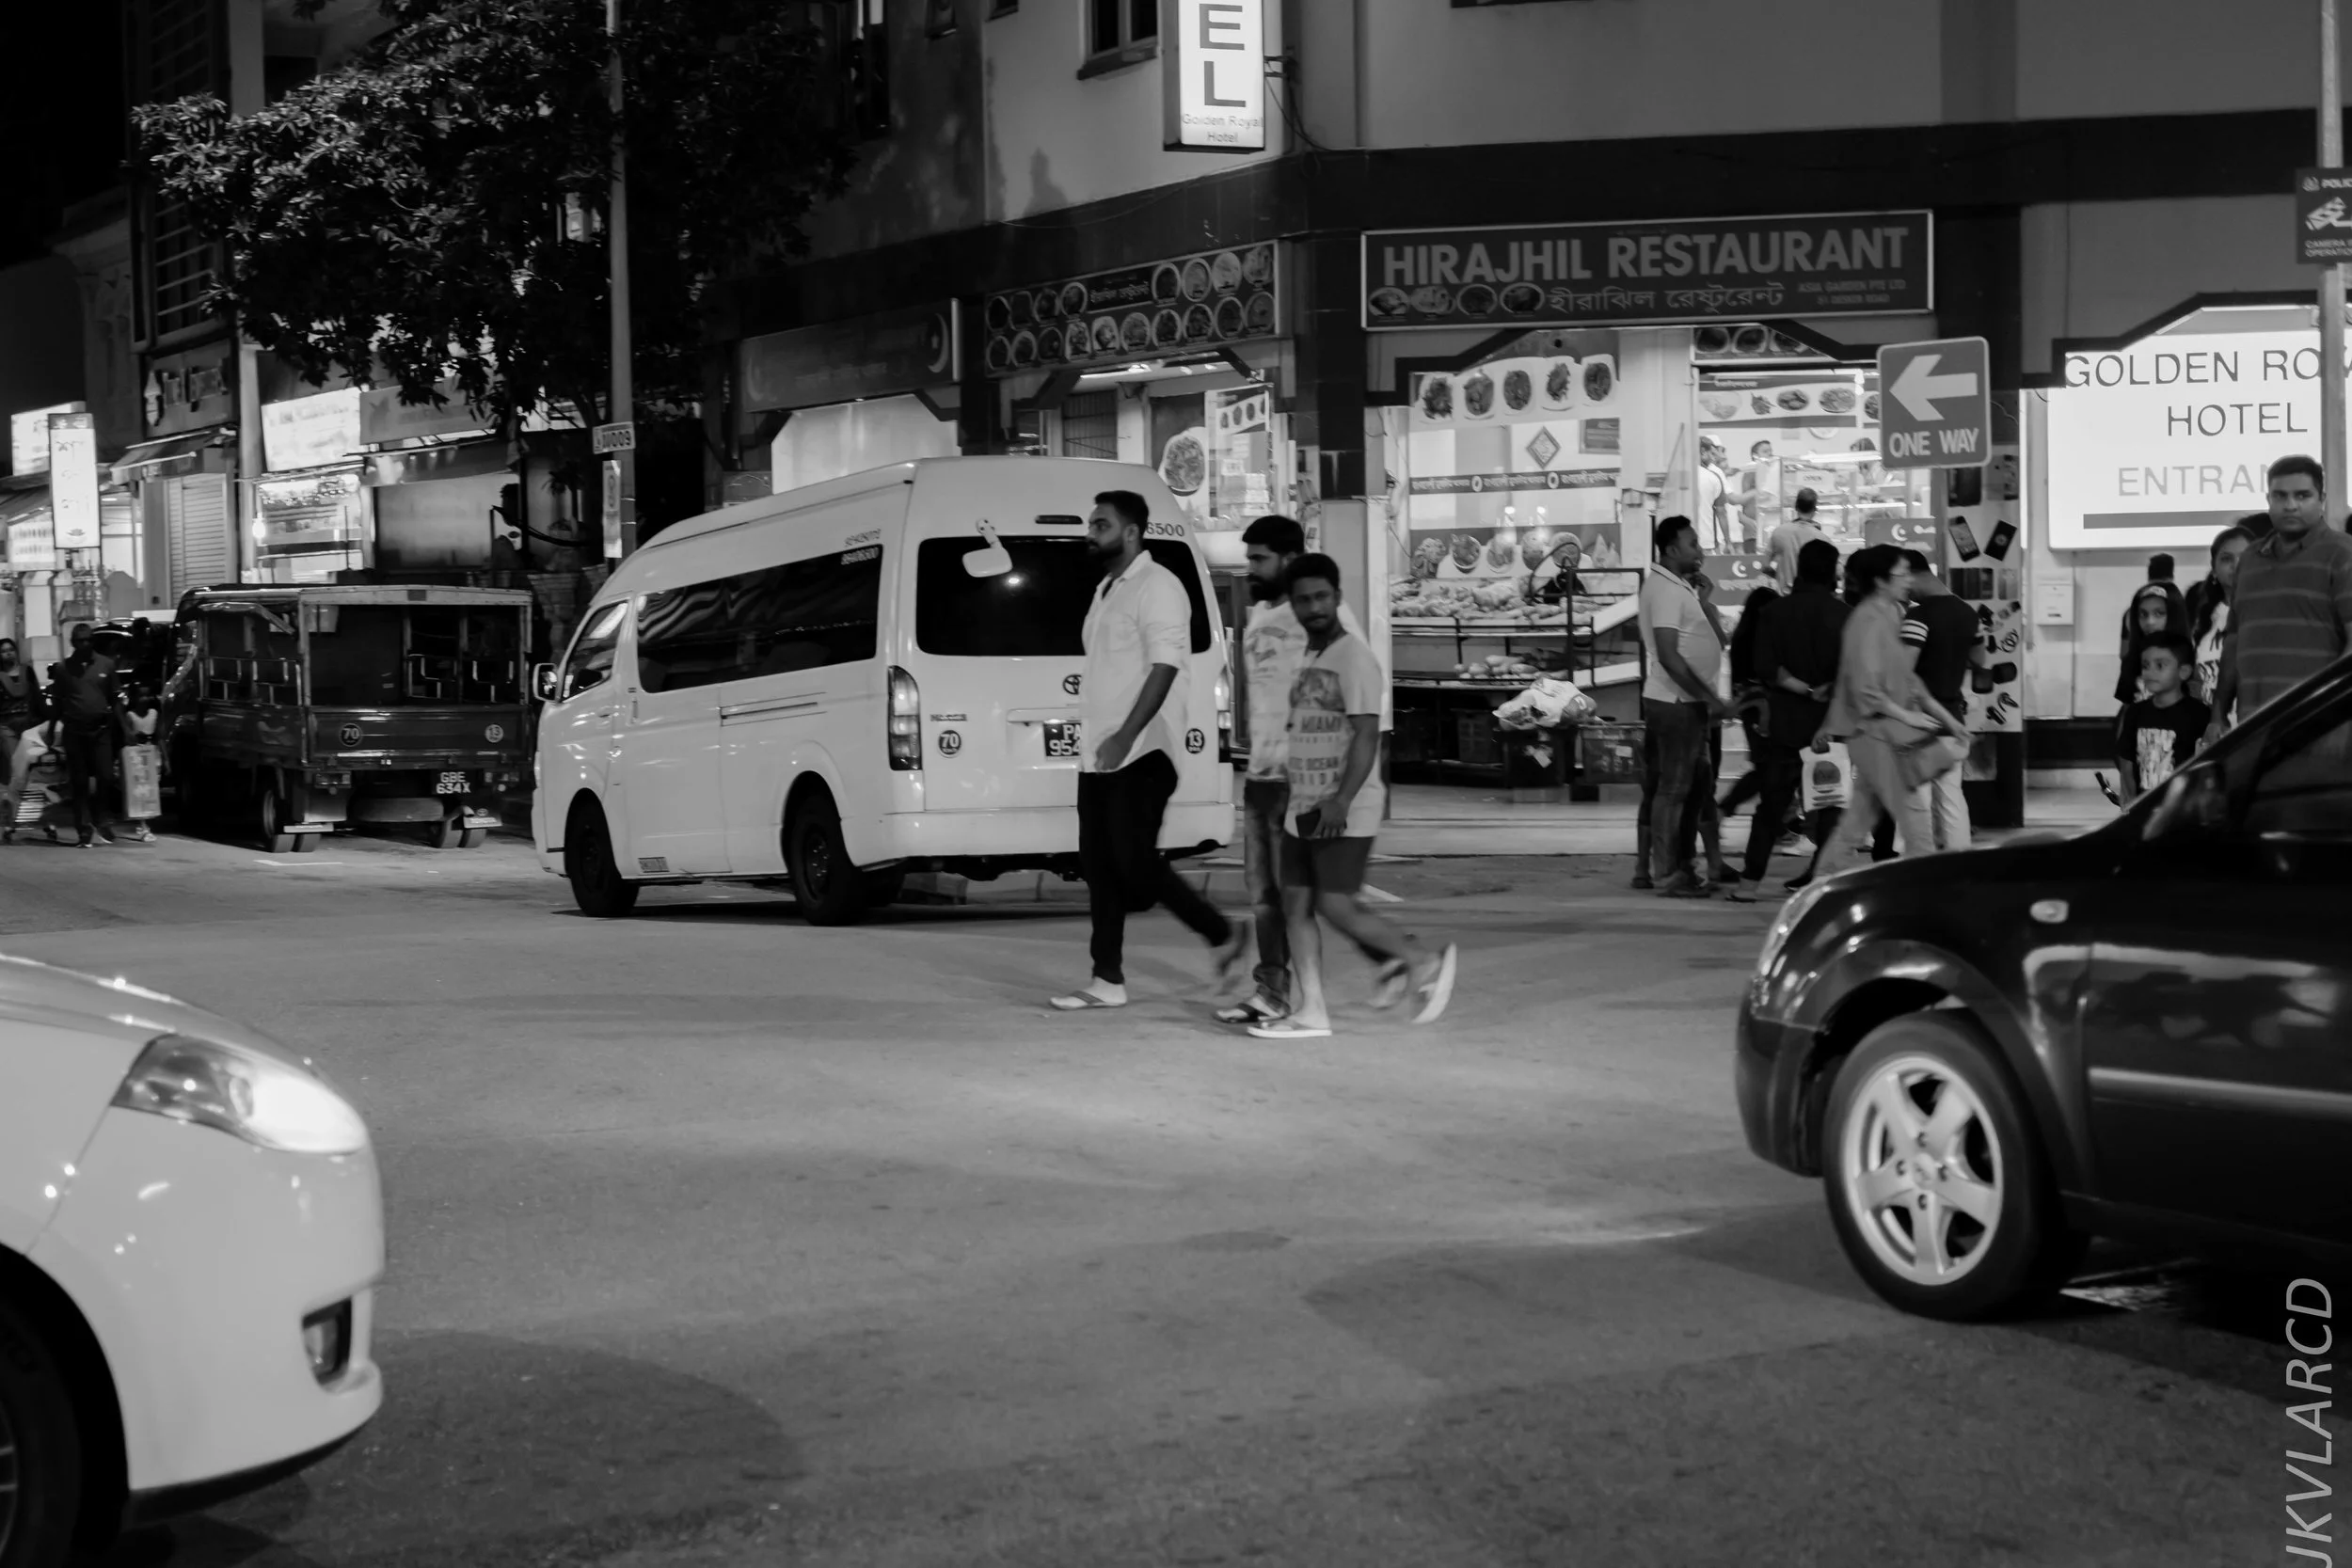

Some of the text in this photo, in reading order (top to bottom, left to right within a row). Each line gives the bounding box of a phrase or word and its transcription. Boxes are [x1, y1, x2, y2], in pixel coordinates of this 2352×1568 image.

[1182, 113, 1264, 130] Golden Royal
[1207, 131, 1238, 143] Hotel
[1383, 227, 1909, 286] HIRAJHIL RESTAURANT
[2064, 351, 2238, 388] GOLDEN
[2168, 402, 2308, 437] HOTEL
[1889, 427, 1979, 458] ONE WAY
[1147, 522, 1184, 537] 6500
[343, 727, 359, 739] 70
[941, 733, 960, 748] 70
[1187, 731, 1202, 747] 13
[440, 771, 466, 784] GBE
[436, 783, 471, 794] 634X
